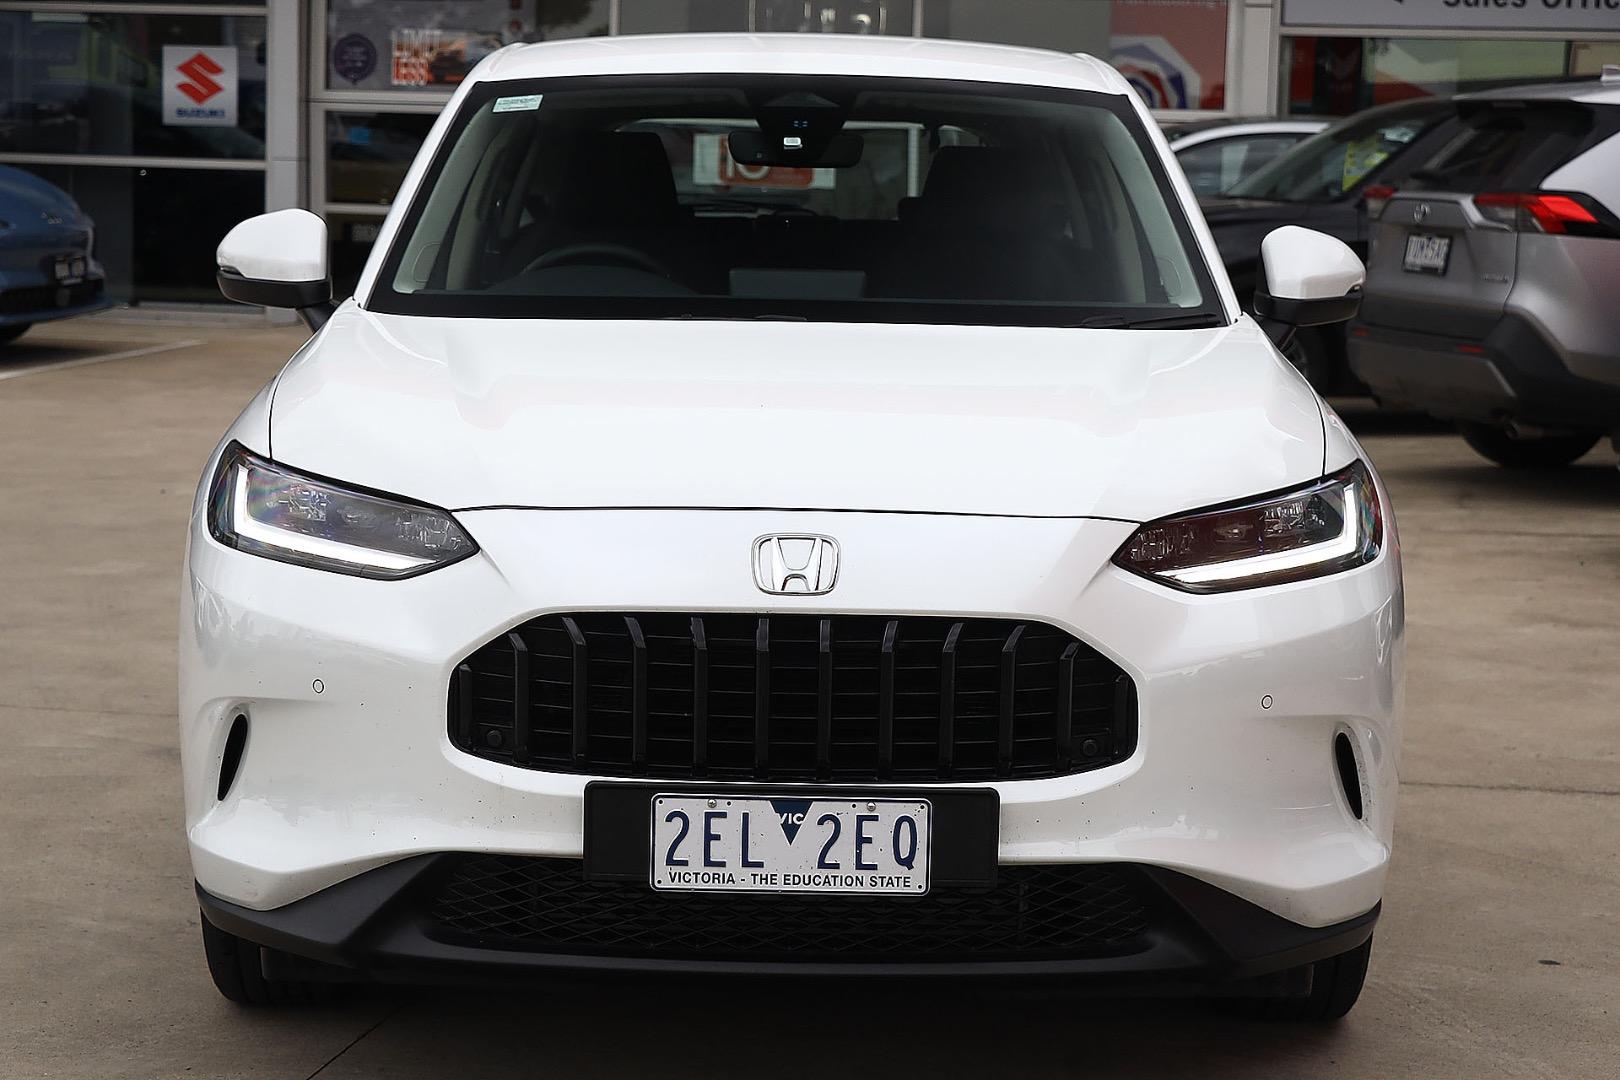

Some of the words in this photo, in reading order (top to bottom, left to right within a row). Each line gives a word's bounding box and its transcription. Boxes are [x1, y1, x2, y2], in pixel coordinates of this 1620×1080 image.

[176, 108, 225, 118] SUZUKI
[777, 812, 804, 825] VIC
[665, 810, 764, 868] 2EL
[817, 813, 917, 870] 2EQ
[668, 871, 736, 885] VICTORIA
[750, 873, 778, 886] THE
[783, 873, 864, 887] EDUCATION
[868, 875, 912, 888] STATE
